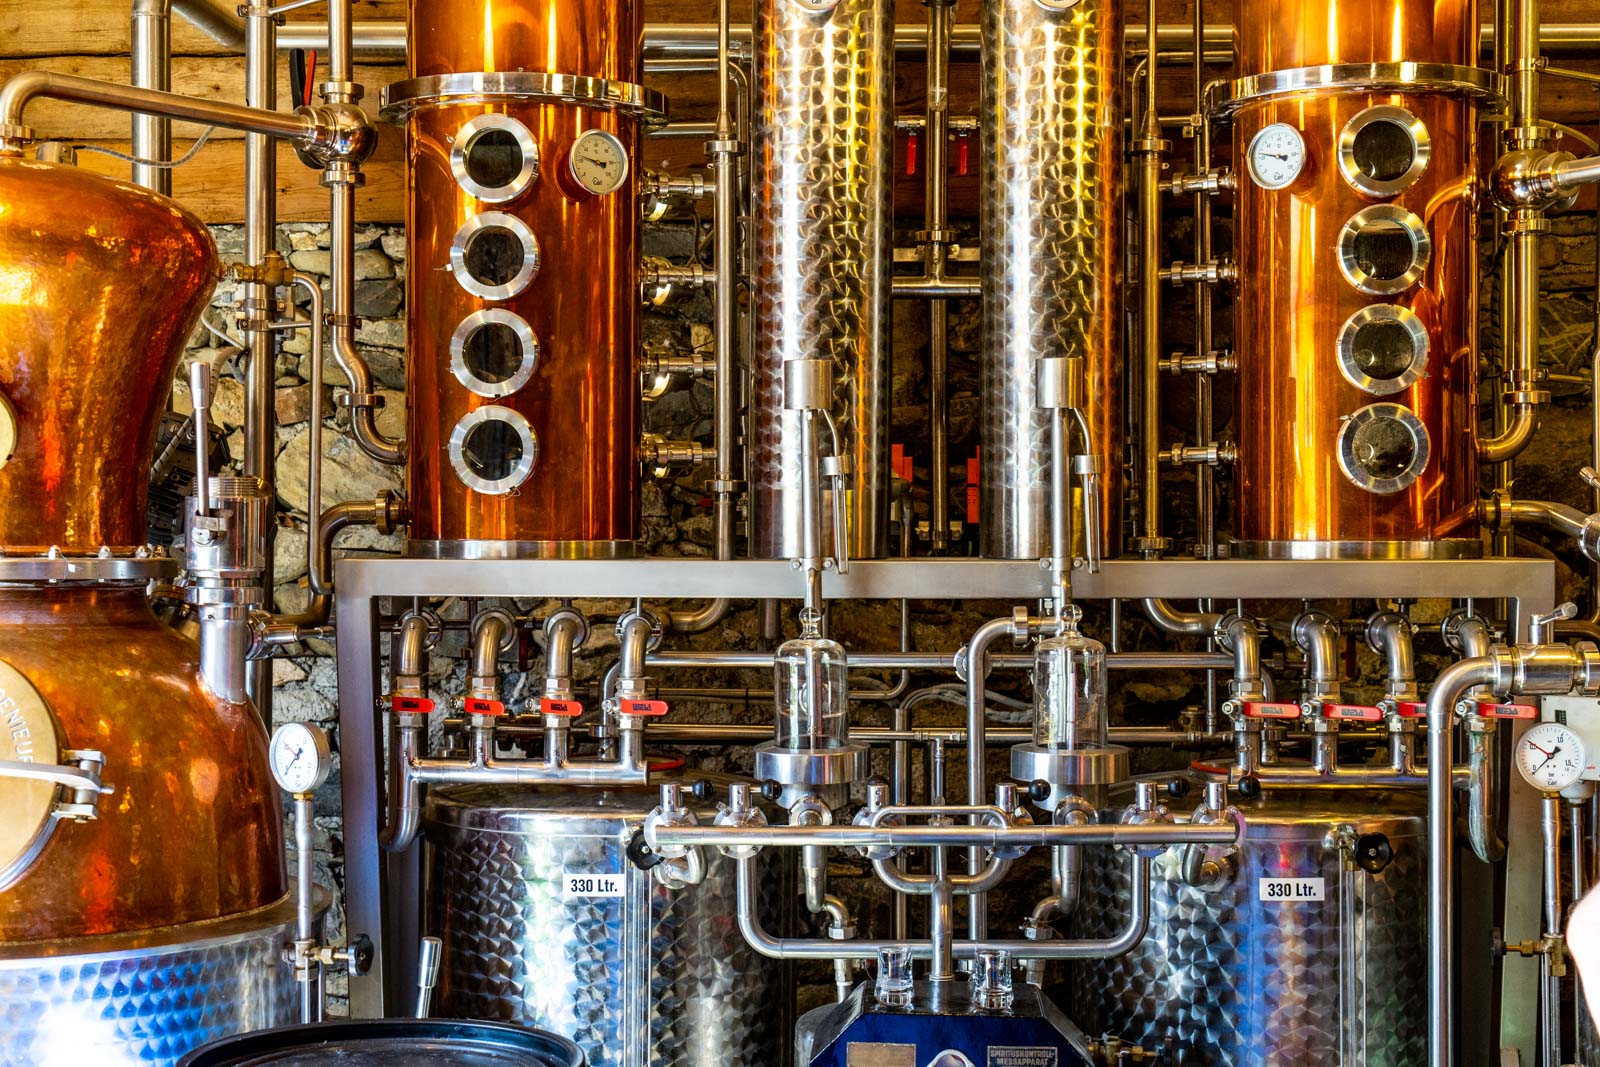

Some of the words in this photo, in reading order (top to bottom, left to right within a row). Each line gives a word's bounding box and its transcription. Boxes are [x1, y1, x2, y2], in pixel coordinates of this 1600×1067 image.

[570, 879, 593, 892] 330
[597, 879, 618, 892] Ltr.
[1267, 883, 1291, 897] 330
[1296, 883, 1316, 896] Ltr.
[997, 1057, 1048, 1065] MESSAPPARAT
